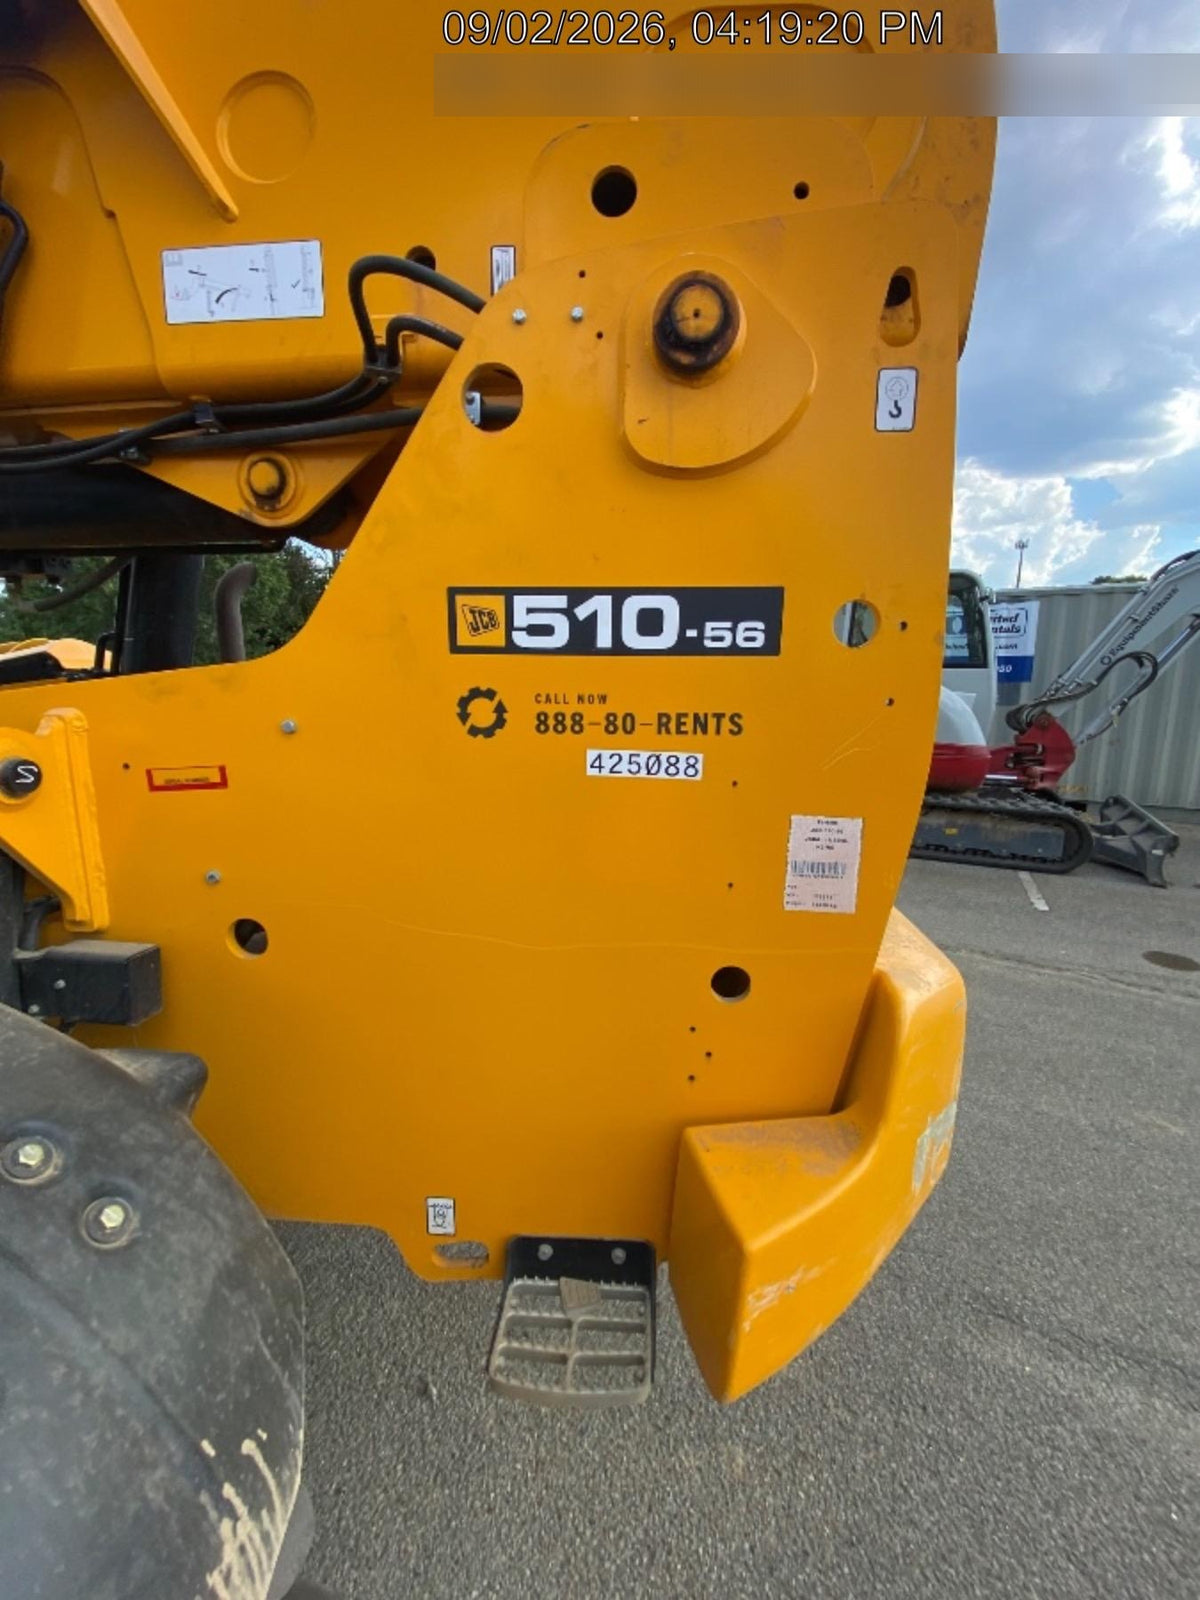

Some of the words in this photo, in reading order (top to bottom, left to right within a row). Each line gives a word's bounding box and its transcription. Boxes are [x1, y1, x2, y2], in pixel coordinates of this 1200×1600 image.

[468, 608, 499, 634] JCB
[534, 692, 570, 705] CALL
[577, 693, 608, 705] NOW
[534, 711, 744, 737] 888-80-RENTS
